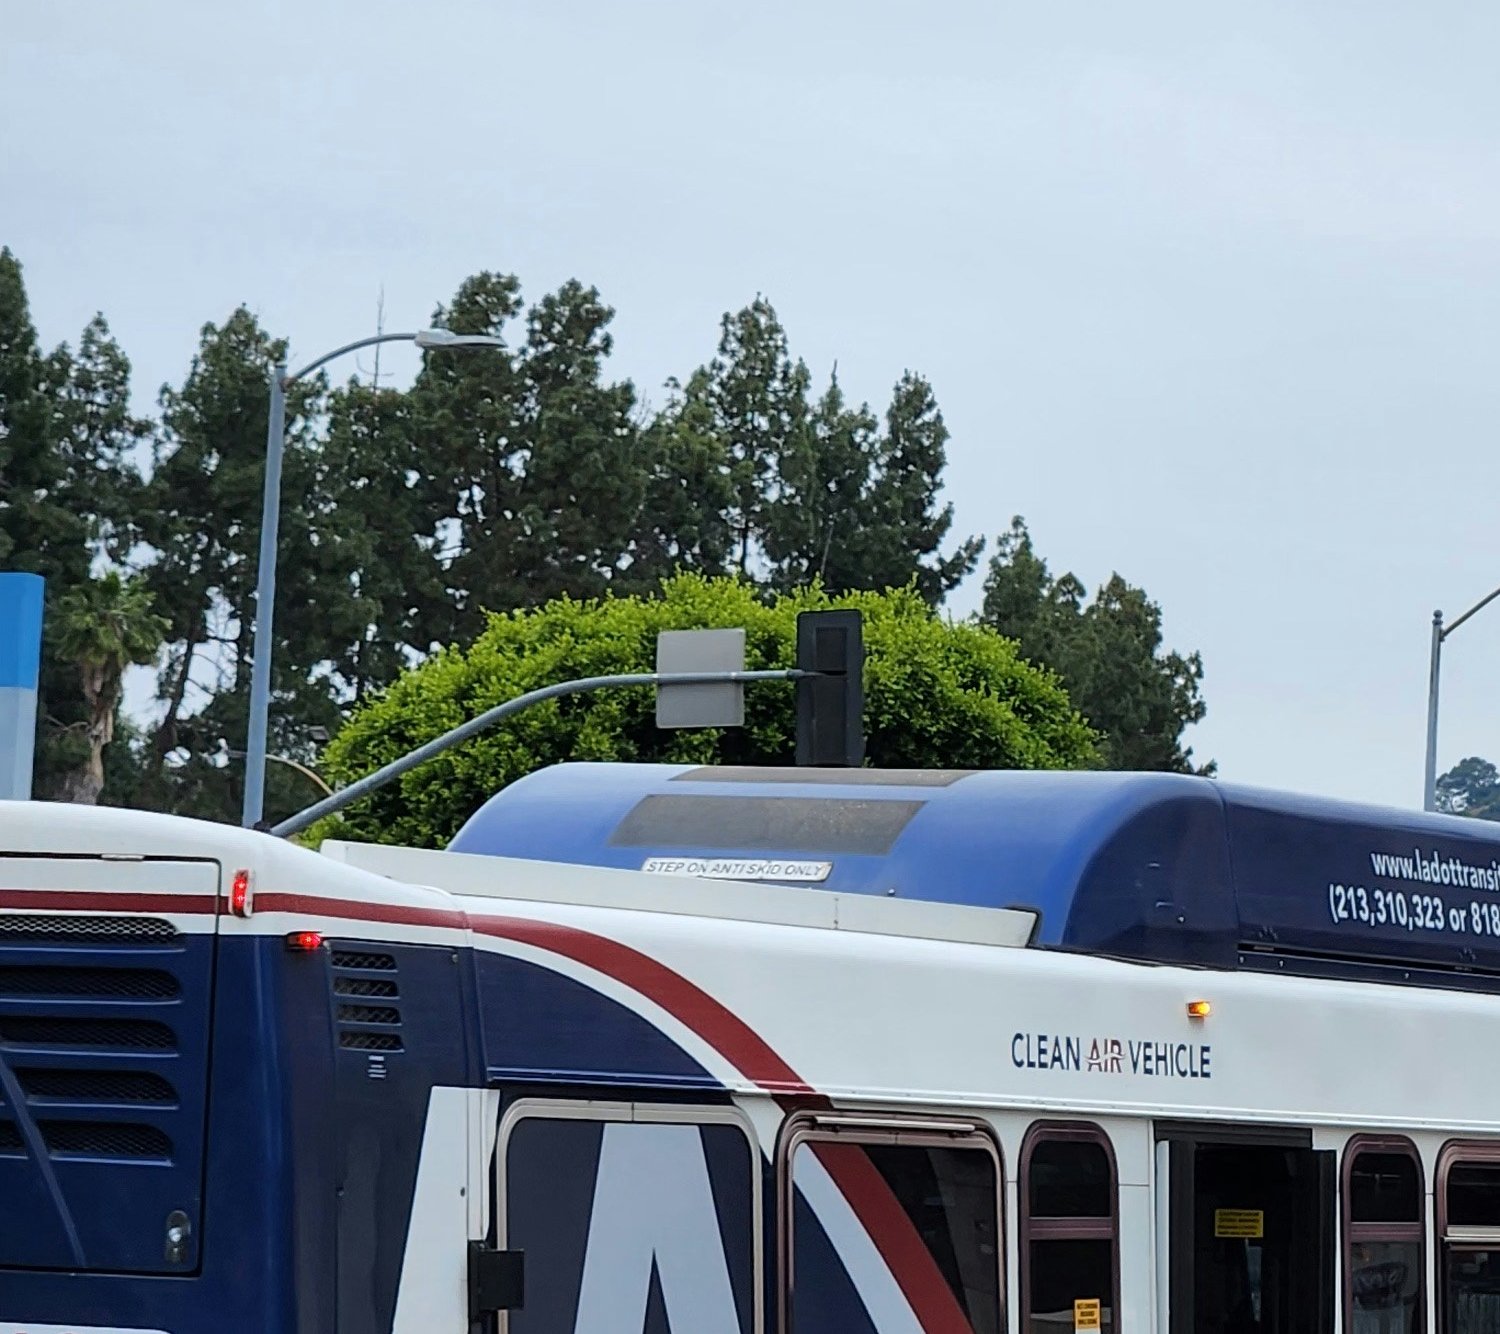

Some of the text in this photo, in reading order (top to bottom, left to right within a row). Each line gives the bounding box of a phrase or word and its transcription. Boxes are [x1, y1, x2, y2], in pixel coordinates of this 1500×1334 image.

[647, 861, 684, 872] STEP
[710, 863, 744, 875] ANTI
[745, 863, 780, 876] SKID
[784, 864, 822, 877] ONLY
[1329, 883, 1445, 932] (213,310,323
[1449, 907, 1467, 933] or
[1011, 1032, 1211, 1078] CLEAN AIR VEHICLE
